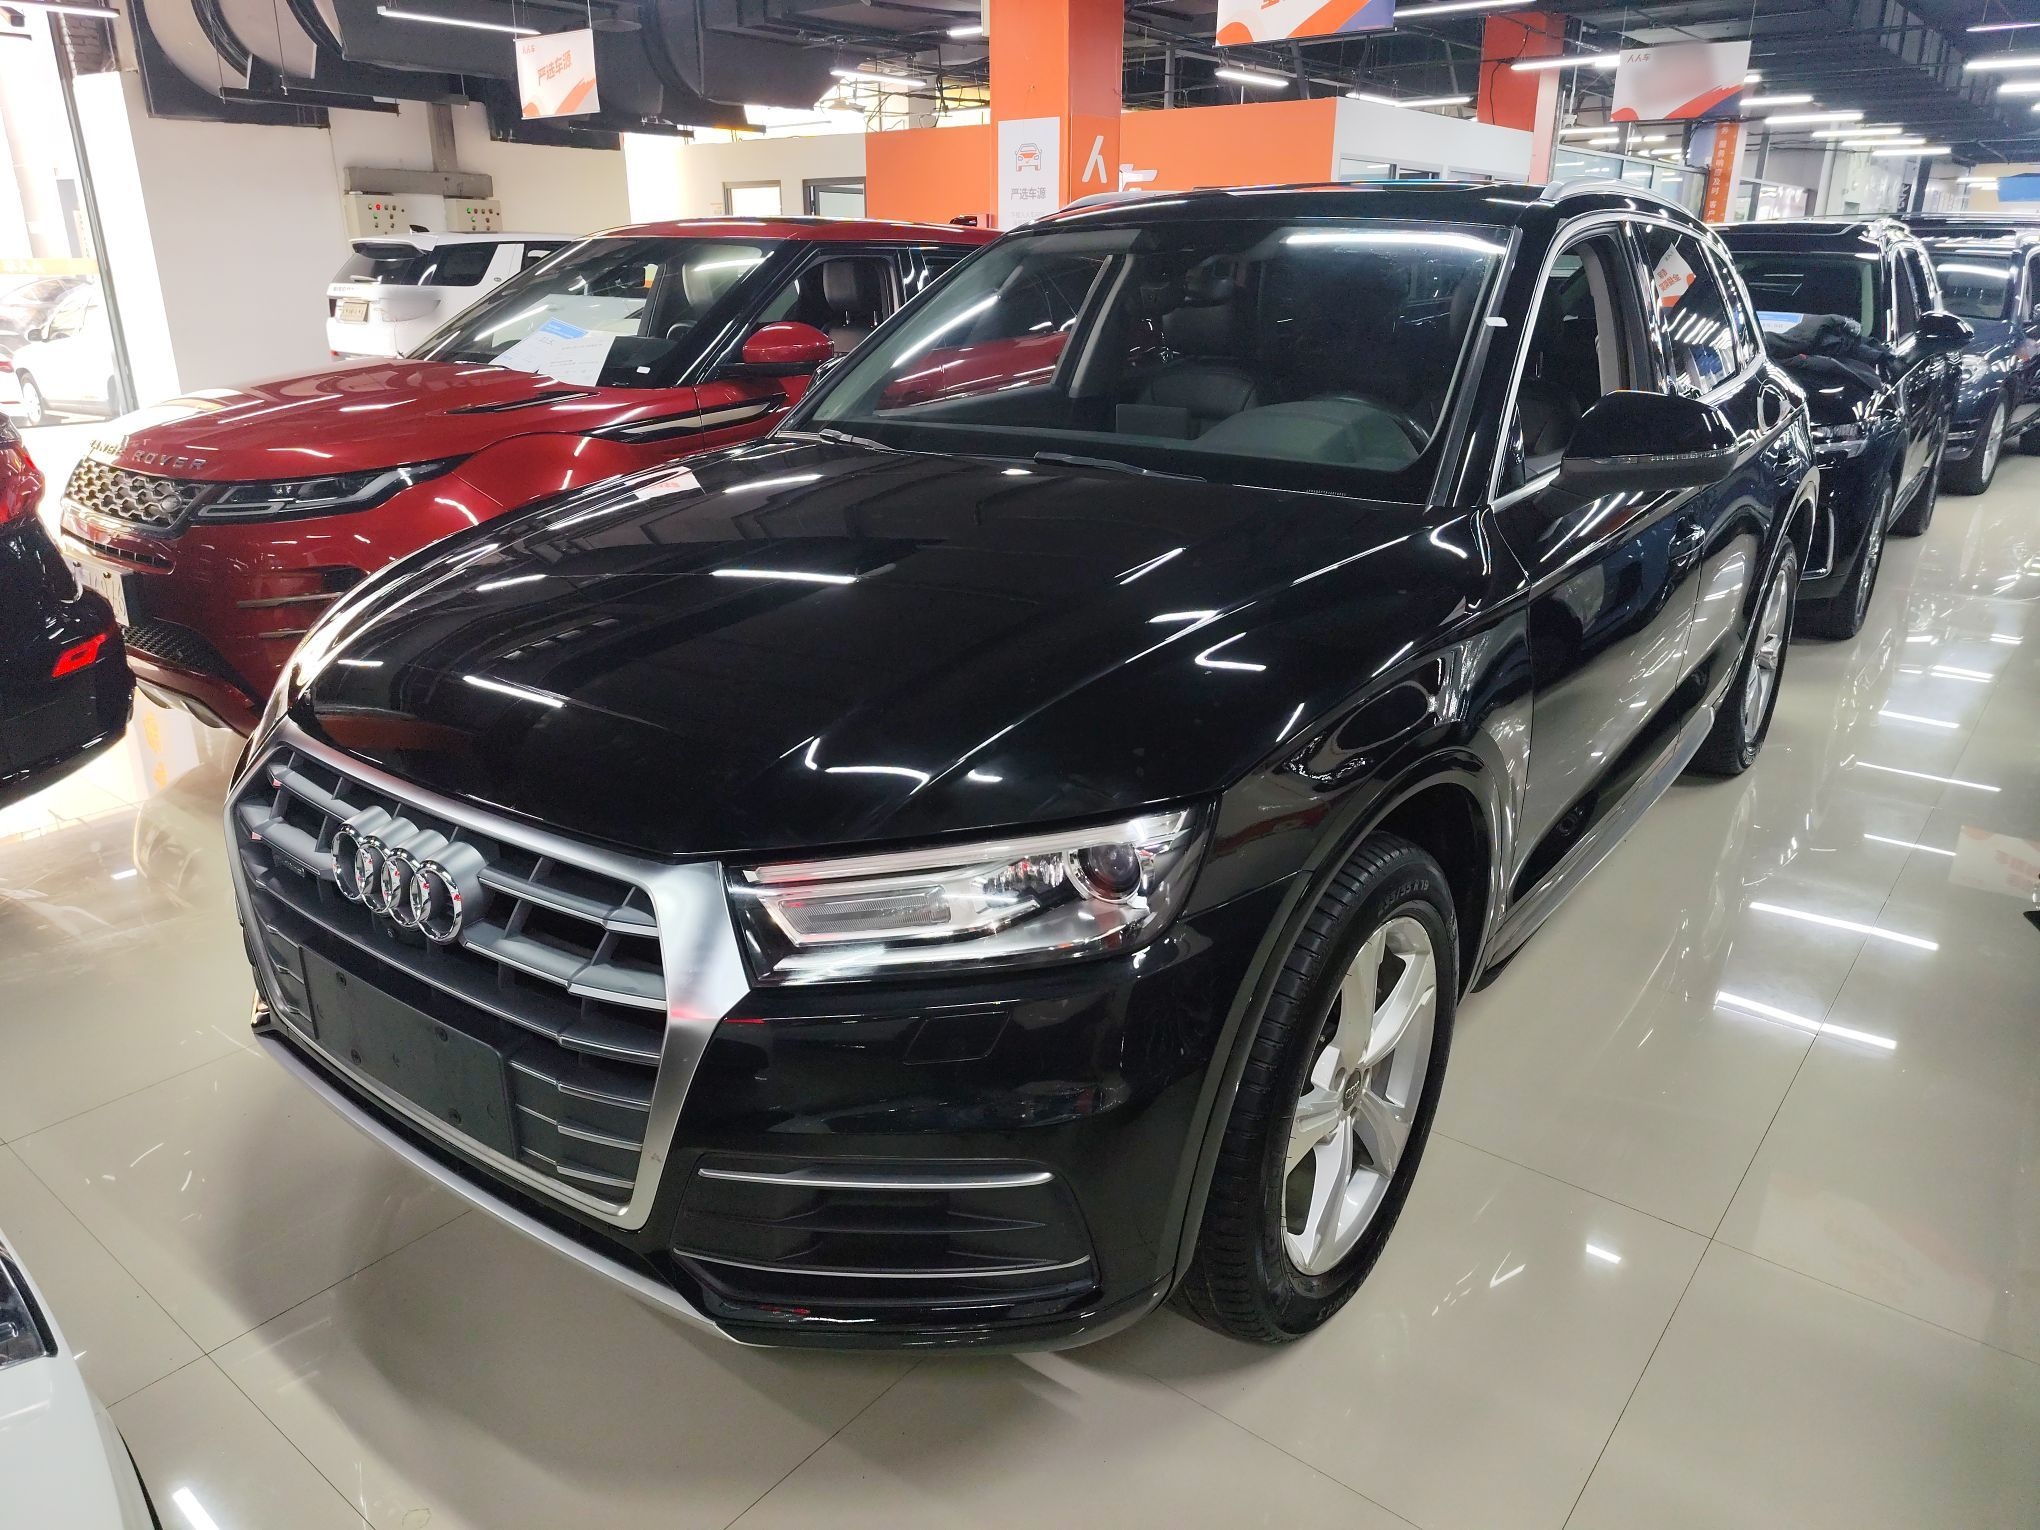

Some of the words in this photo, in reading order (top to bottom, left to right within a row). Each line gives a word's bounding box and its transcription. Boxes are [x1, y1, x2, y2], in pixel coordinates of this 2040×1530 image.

[537, 50, 572, 87] 严选车源
[1010, 187, 1047, 201] 严选车源
[132, 450, 207, 471] ROVER
[1420, 879, 1430, 891] 19
